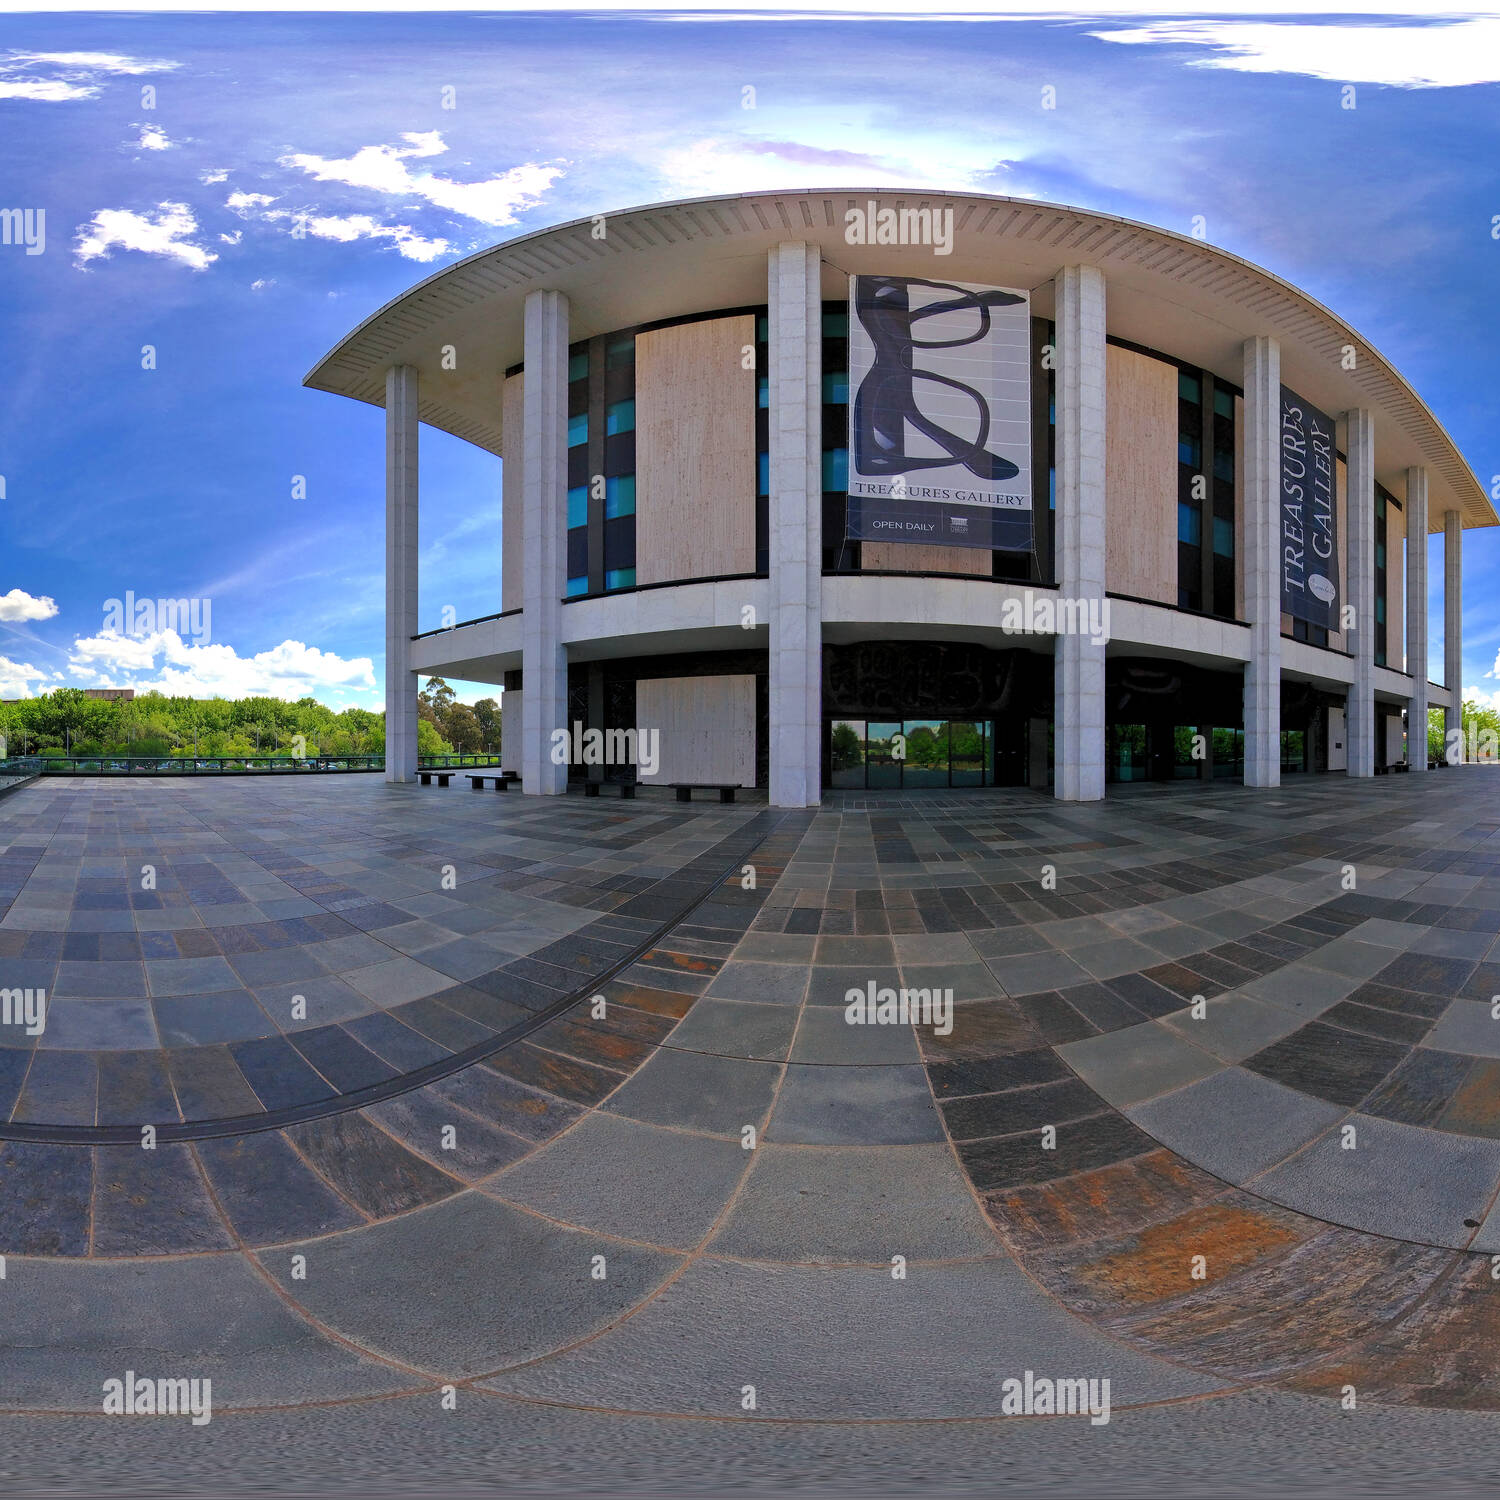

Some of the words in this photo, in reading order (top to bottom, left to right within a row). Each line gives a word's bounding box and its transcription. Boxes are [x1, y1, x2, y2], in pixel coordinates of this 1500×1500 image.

[855, 482, 950, 499] TREASURES
[955, 490, 1025, 506] GALLERY
[872, 520, 903, 529] OPEN
[906, 522, 935, 532] DAILY
[1282, 401, 1306, 593] TREASURES
[1311, 419, 1333, 558] GALLERY
